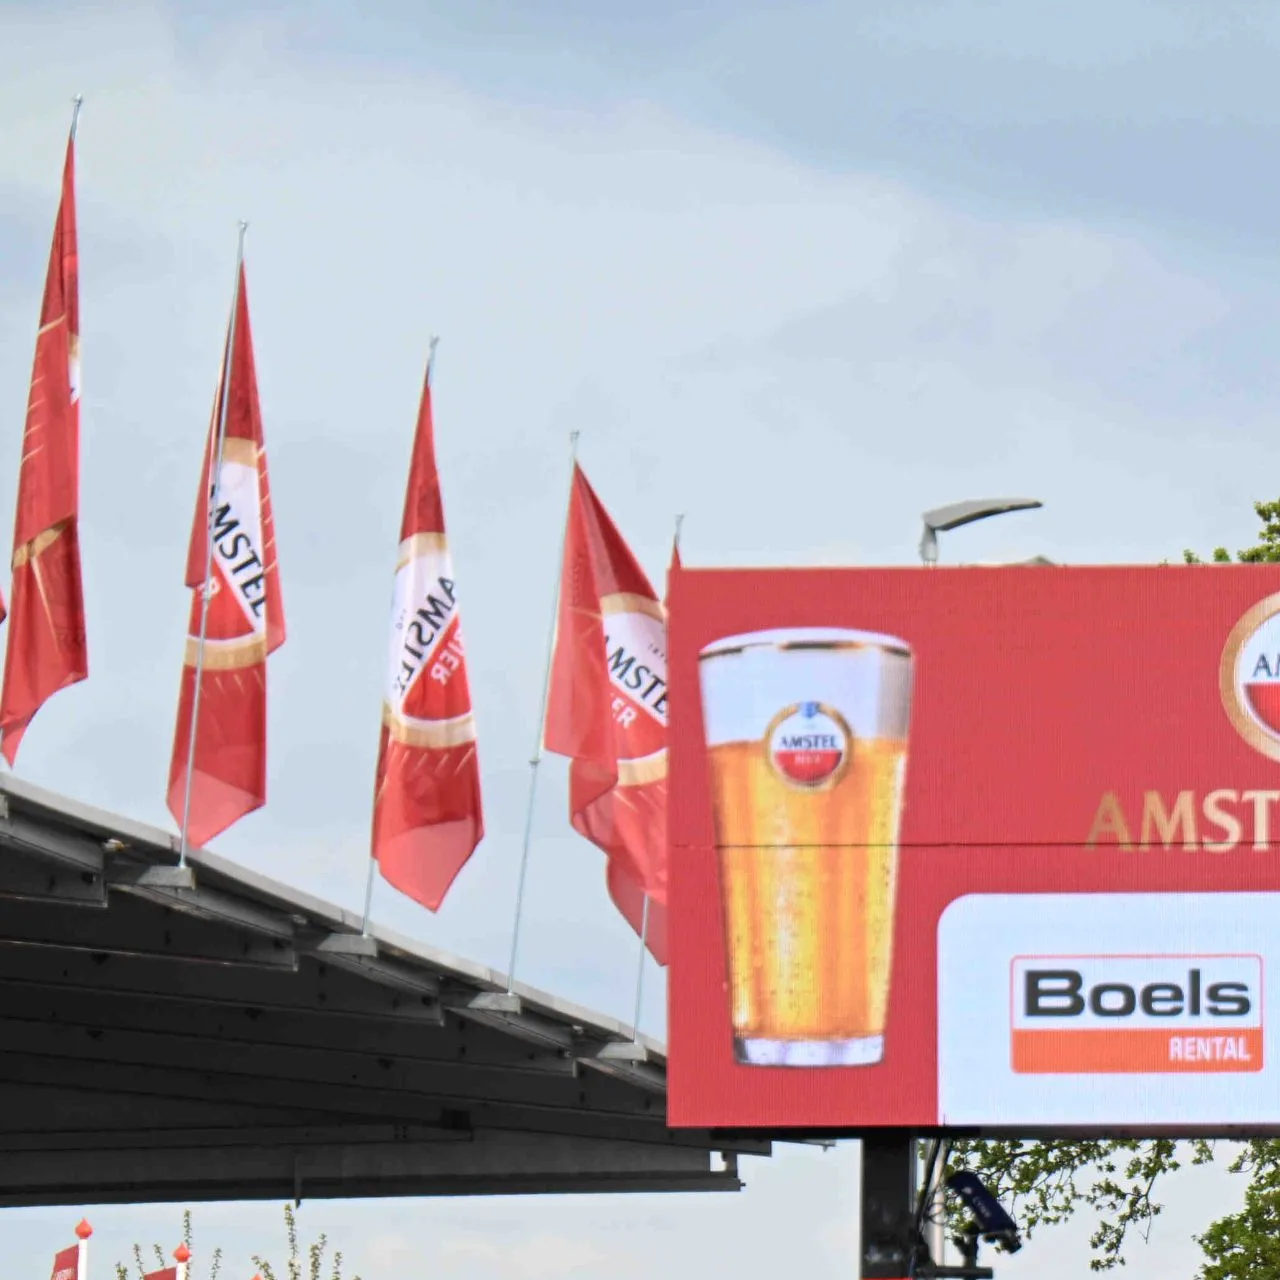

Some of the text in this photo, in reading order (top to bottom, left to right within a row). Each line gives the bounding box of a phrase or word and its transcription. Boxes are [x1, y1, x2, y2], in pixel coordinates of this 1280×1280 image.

[210, 484, 267, 618] MSTEL
[780, 734, 838, 749] AMSTEL
[1023, 968, 1252, 1018] Boels
[1168, 1036, 1252, 1061] RENTAL
